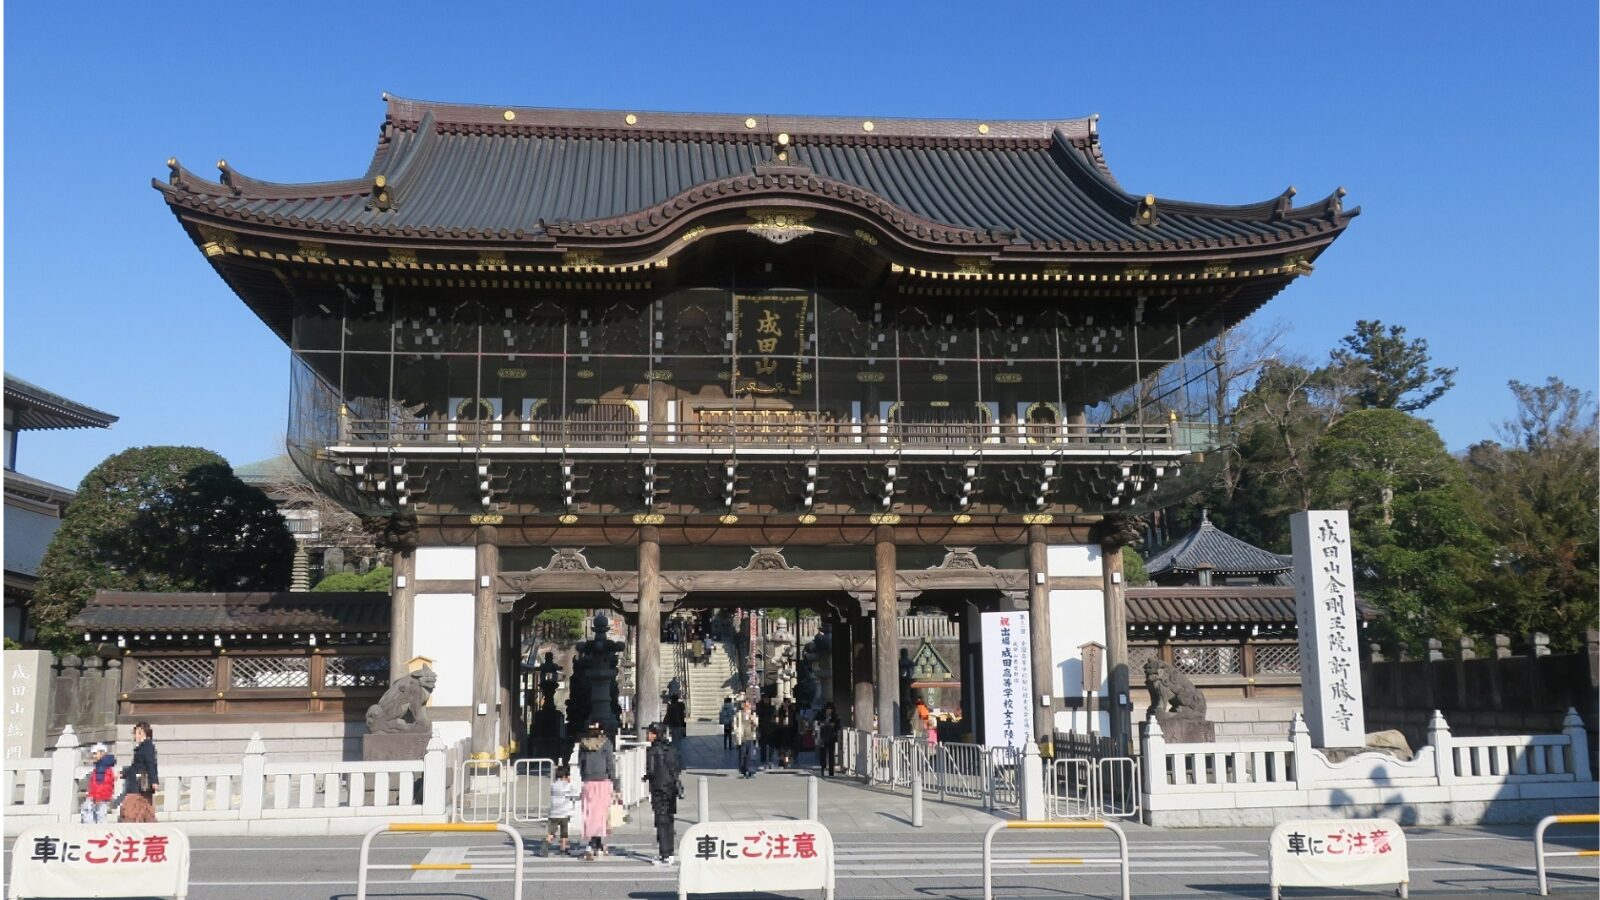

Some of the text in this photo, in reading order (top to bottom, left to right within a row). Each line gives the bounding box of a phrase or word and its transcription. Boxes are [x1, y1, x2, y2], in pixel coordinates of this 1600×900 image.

[755, 309, 782, 375] 成田山
[31, 832, 169, 864] 車にご注意
[695, 830, 818, 860] 車にご注意
[1286, 828, 1392, 856] 車にご注意
